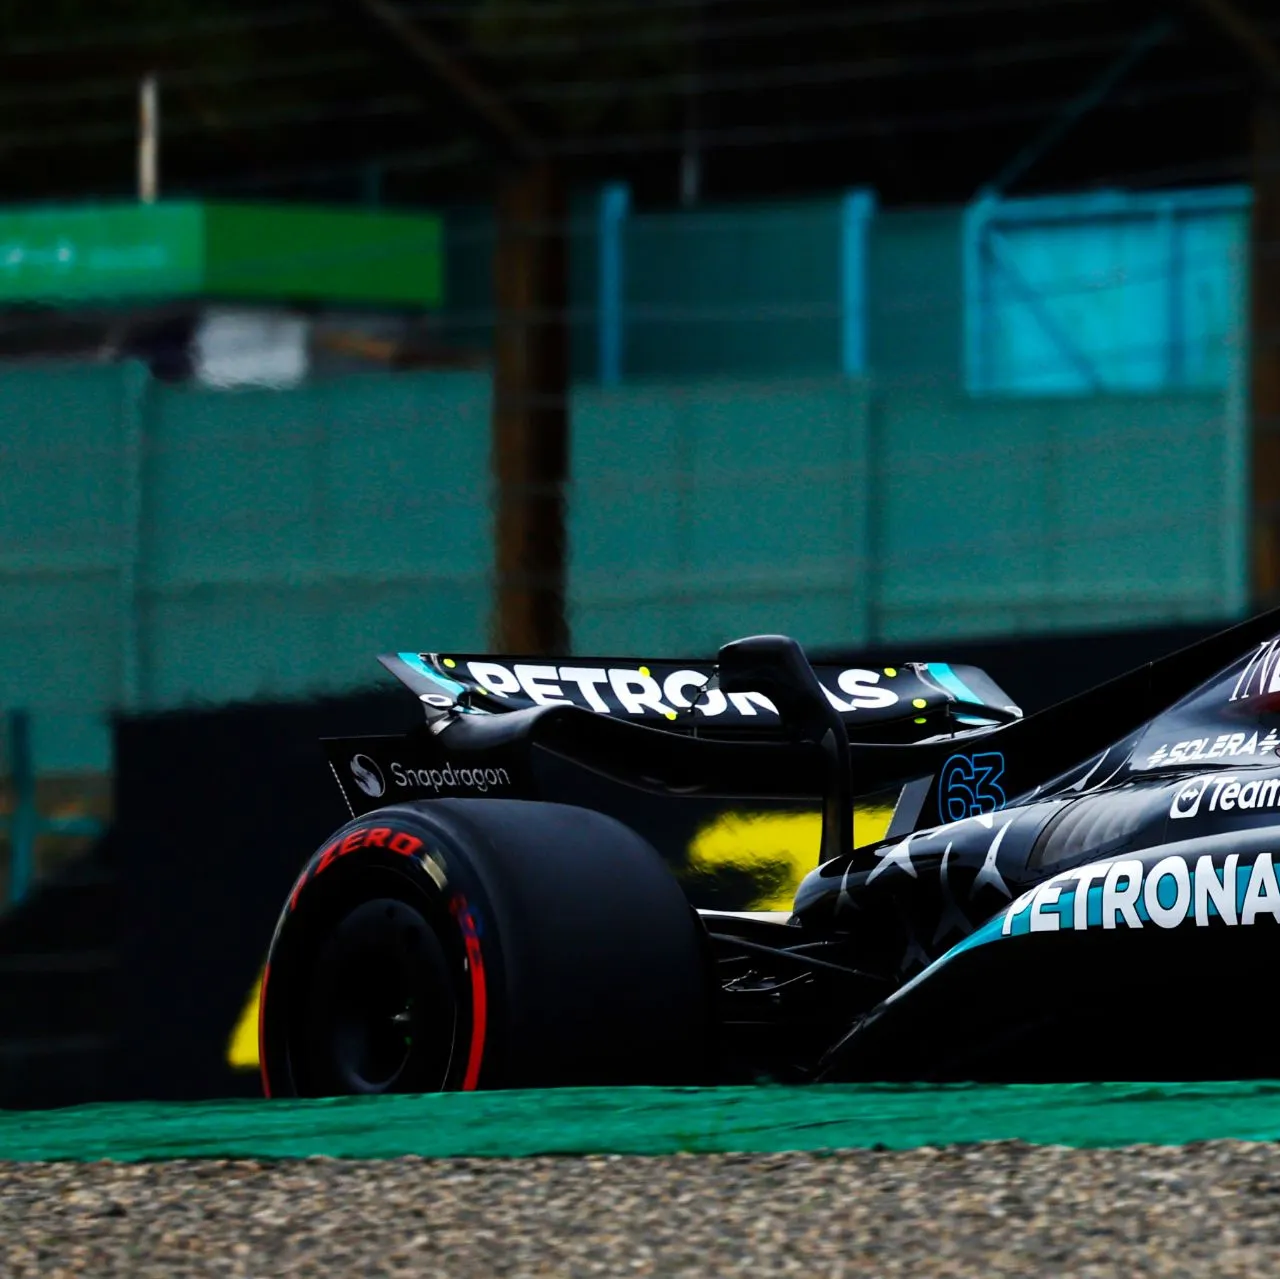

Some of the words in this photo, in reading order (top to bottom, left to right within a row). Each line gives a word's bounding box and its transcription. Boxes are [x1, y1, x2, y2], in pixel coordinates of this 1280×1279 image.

[467, 662, 899, 715] PETROS
[1165, 731, 1259, 765] SOLERA
[390, 761, 511, 793] Snapdragon
[938, 751, 1006, 825] 63
[313, 827, 425, 876] ZERO
